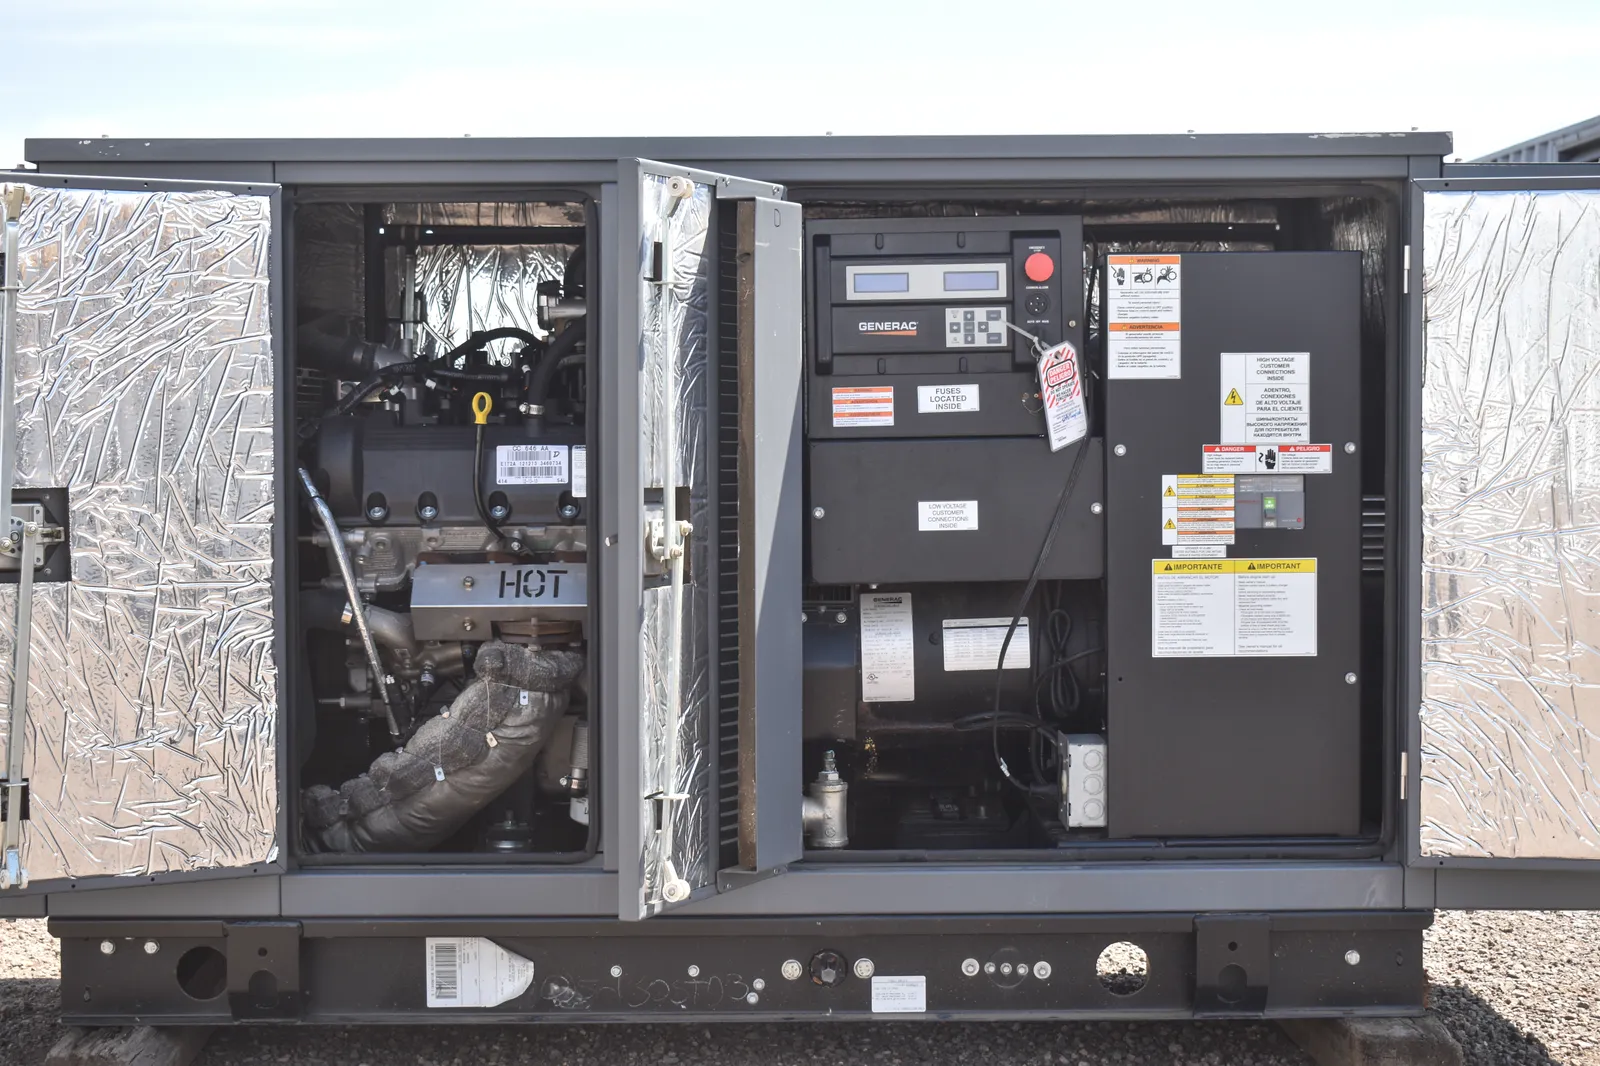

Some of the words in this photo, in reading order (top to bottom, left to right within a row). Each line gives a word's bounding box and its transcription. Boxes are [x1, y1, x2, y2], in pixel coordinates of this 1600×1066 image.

[859, 321, 917, 331] GENERAC
[1049, 363, 1070, 377] DANGER
[1173, 563, 1223, 571] IMPORTANTE
[1256, 562, 1301, 570] IMPORTANT
[499, 569, 568, 598] HOT
